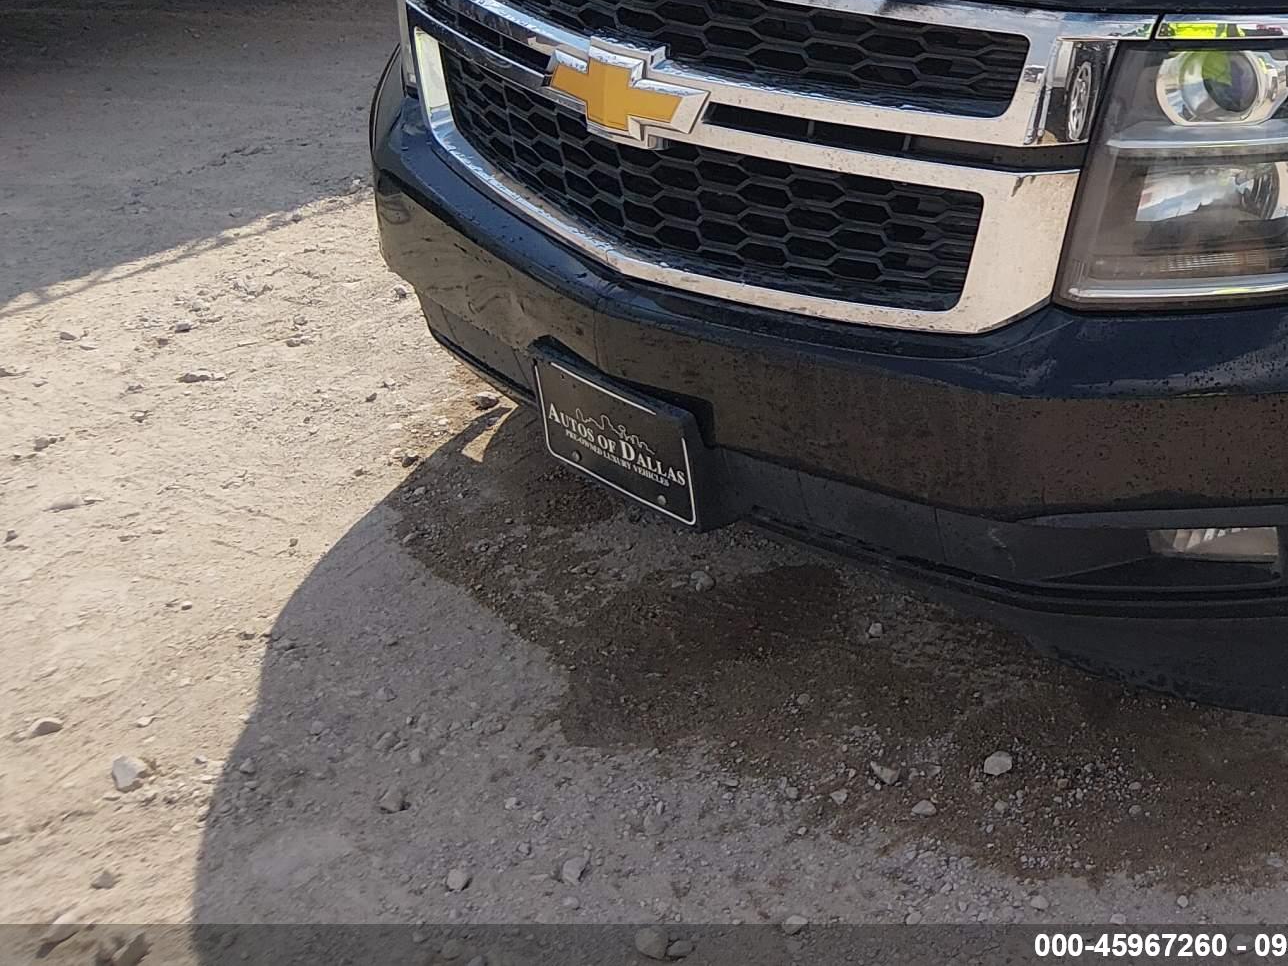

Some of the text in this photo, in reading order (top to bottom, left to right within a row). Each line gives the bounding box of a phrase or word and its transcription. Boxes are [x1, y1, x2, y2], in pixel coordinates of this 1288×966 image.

[548, 403, 686, 486] AUTOS OF DALLAS
[603, 450, 632, 470] LUXURY
[633, 464, 670, 487] VEHICLES
